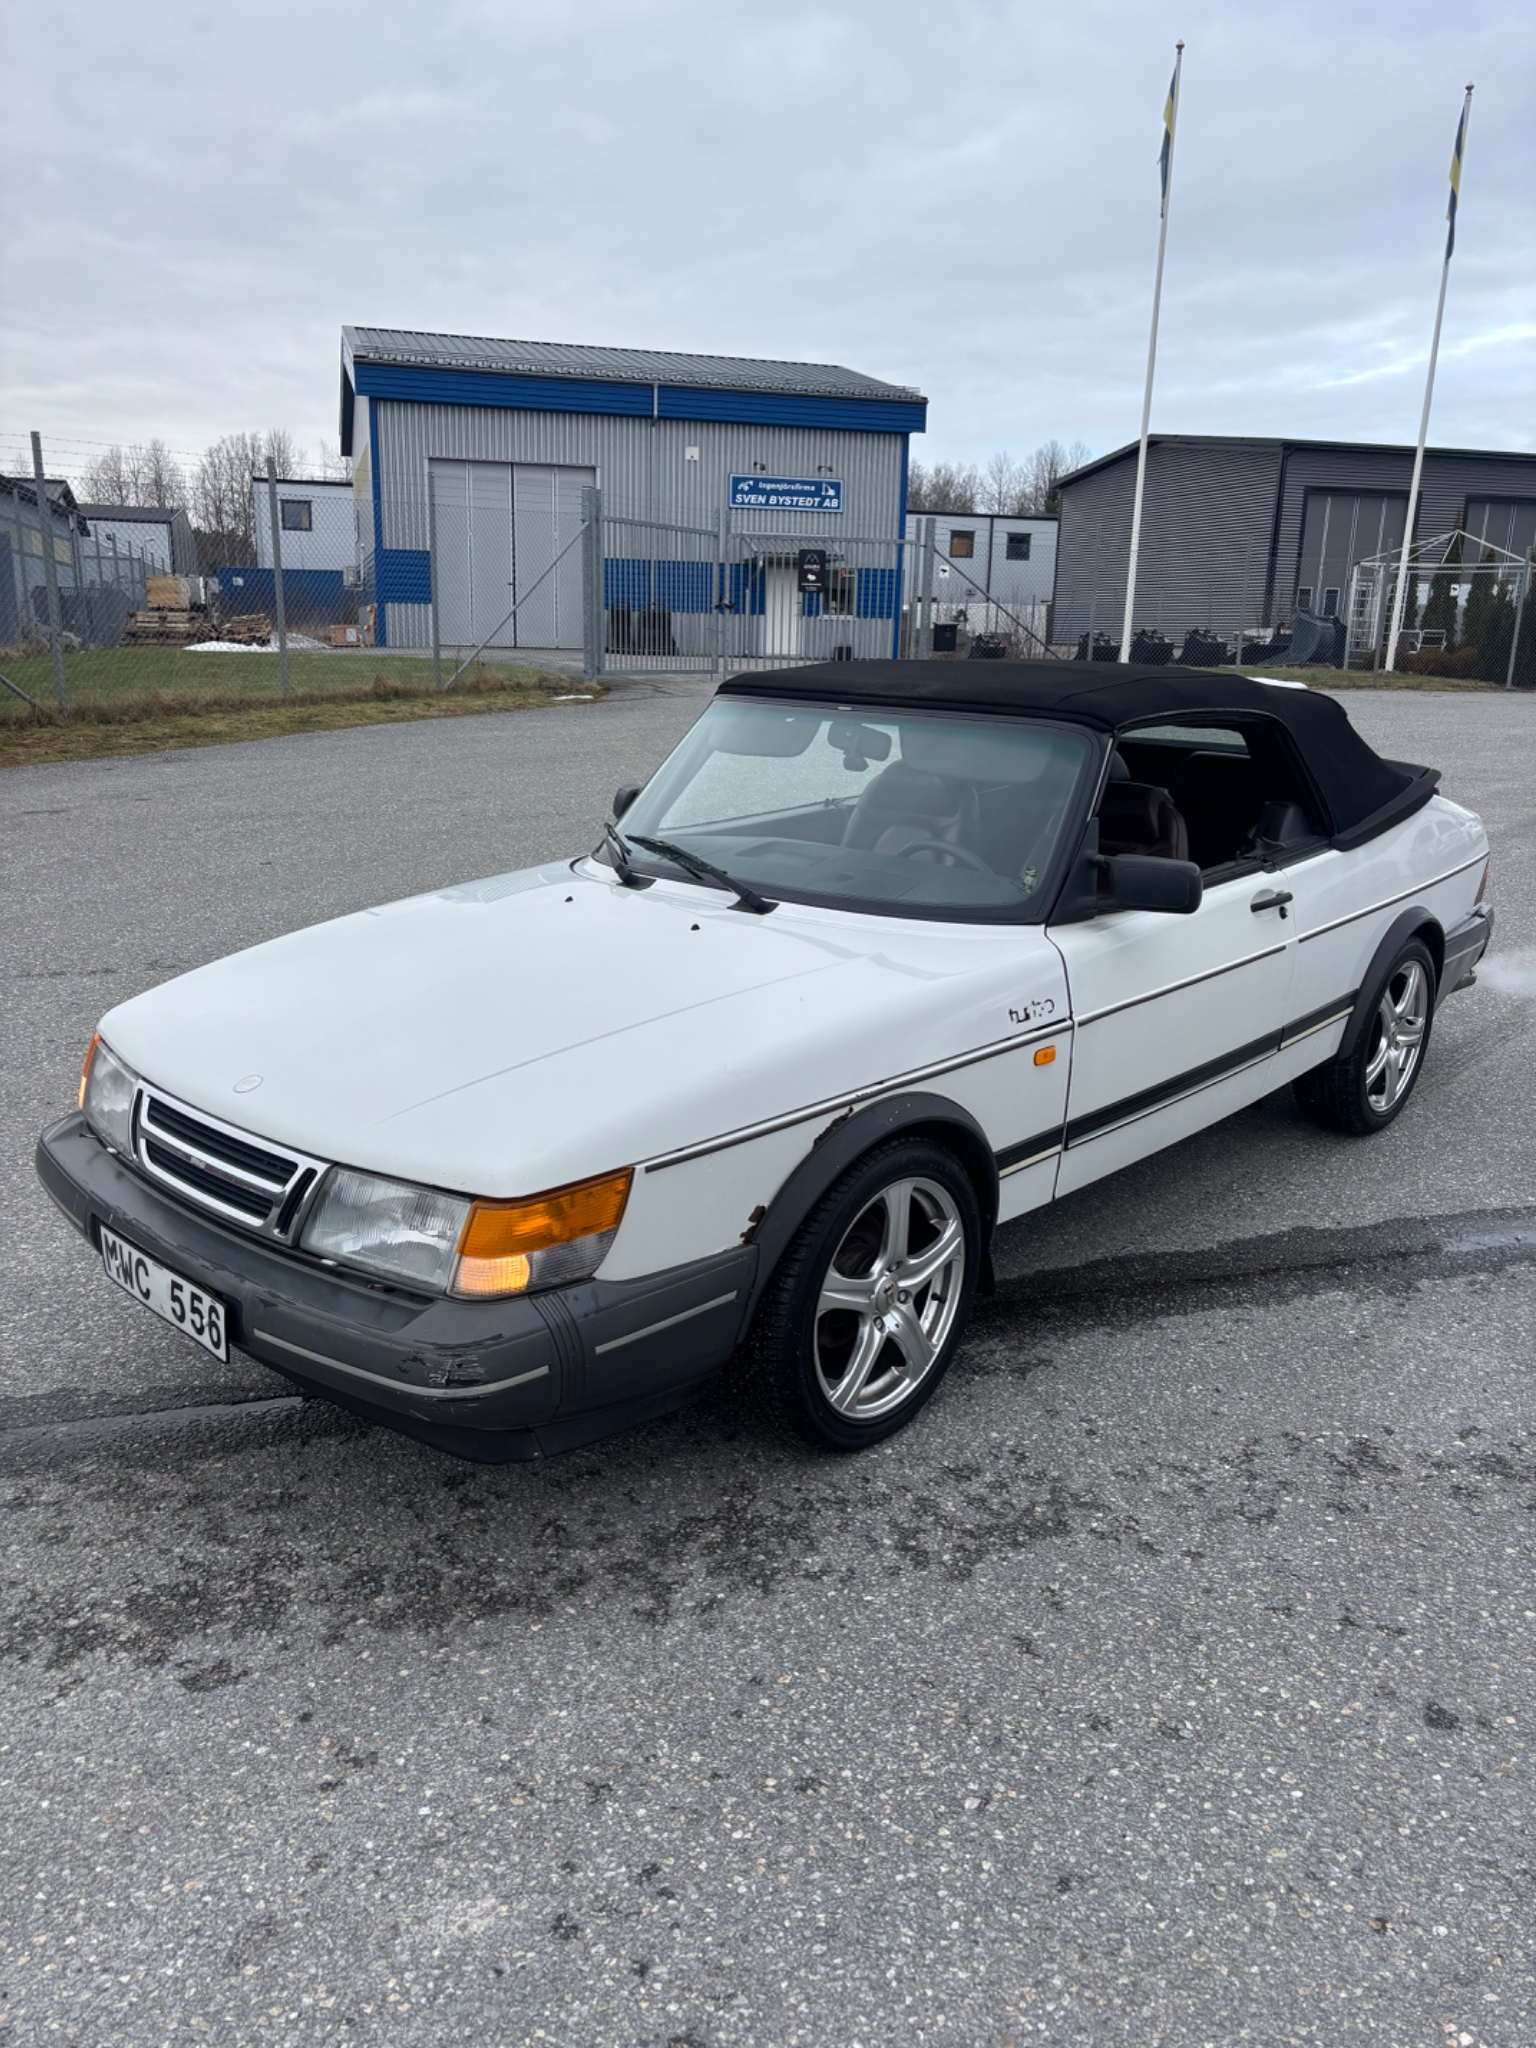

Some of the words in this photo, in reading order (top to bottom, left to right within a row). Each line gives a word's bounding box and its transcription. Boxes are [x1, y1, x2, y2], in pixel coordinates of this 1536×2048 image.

[735, 494, 767, 504] SVEN
[768, 495, 821, 506] BYSTEDT
[823, 498, 839, 508] AB
[103, 1232, 151, 1301] MWC
[170, 1279, 222, 1351] 556
